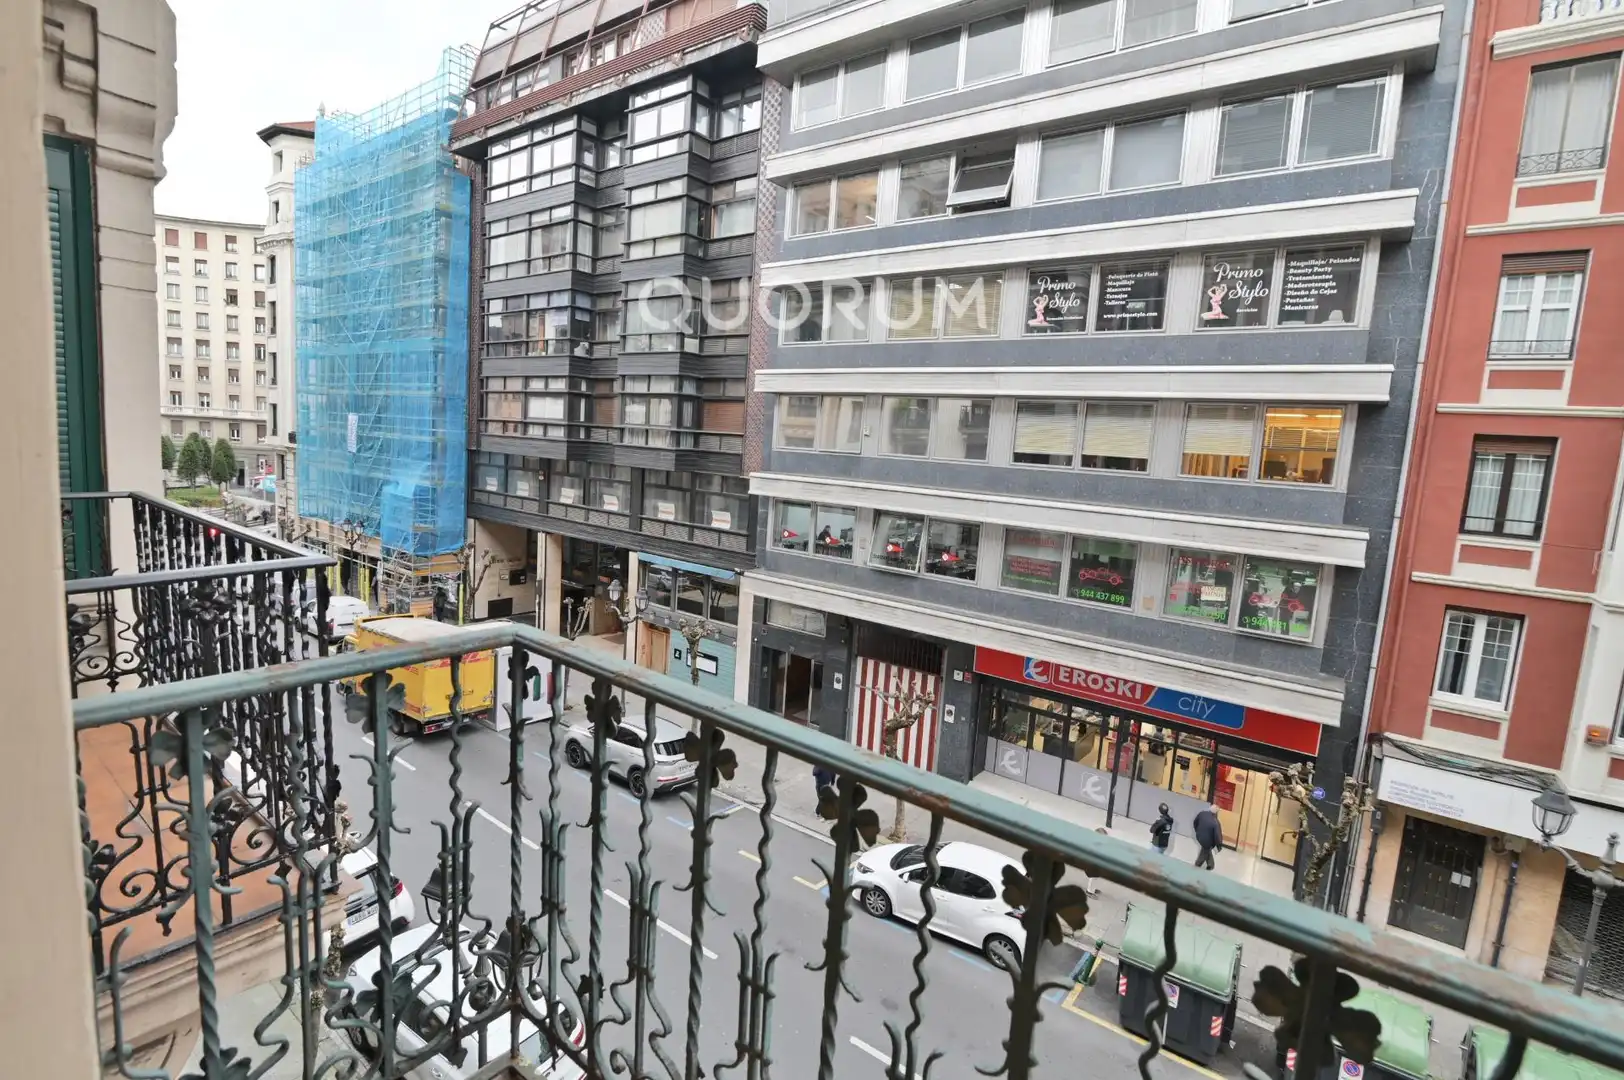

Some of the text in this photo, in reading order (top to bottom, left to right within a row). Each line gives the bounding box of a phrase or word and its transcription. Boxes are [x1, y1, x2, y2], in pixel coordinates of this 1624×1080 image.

[1213, 262, 1263, 282] Primo
[1037, 276, 1076, 293] Primo
[1228, 280, 1269, 305] Stylo
[1048, 292, 1080, 313] Stylo
[1080, 589, 1125, 603] 944 437 899
[1058, 665, 1144, 699] EROSKI
[1178, 694, 1216, 719] city
